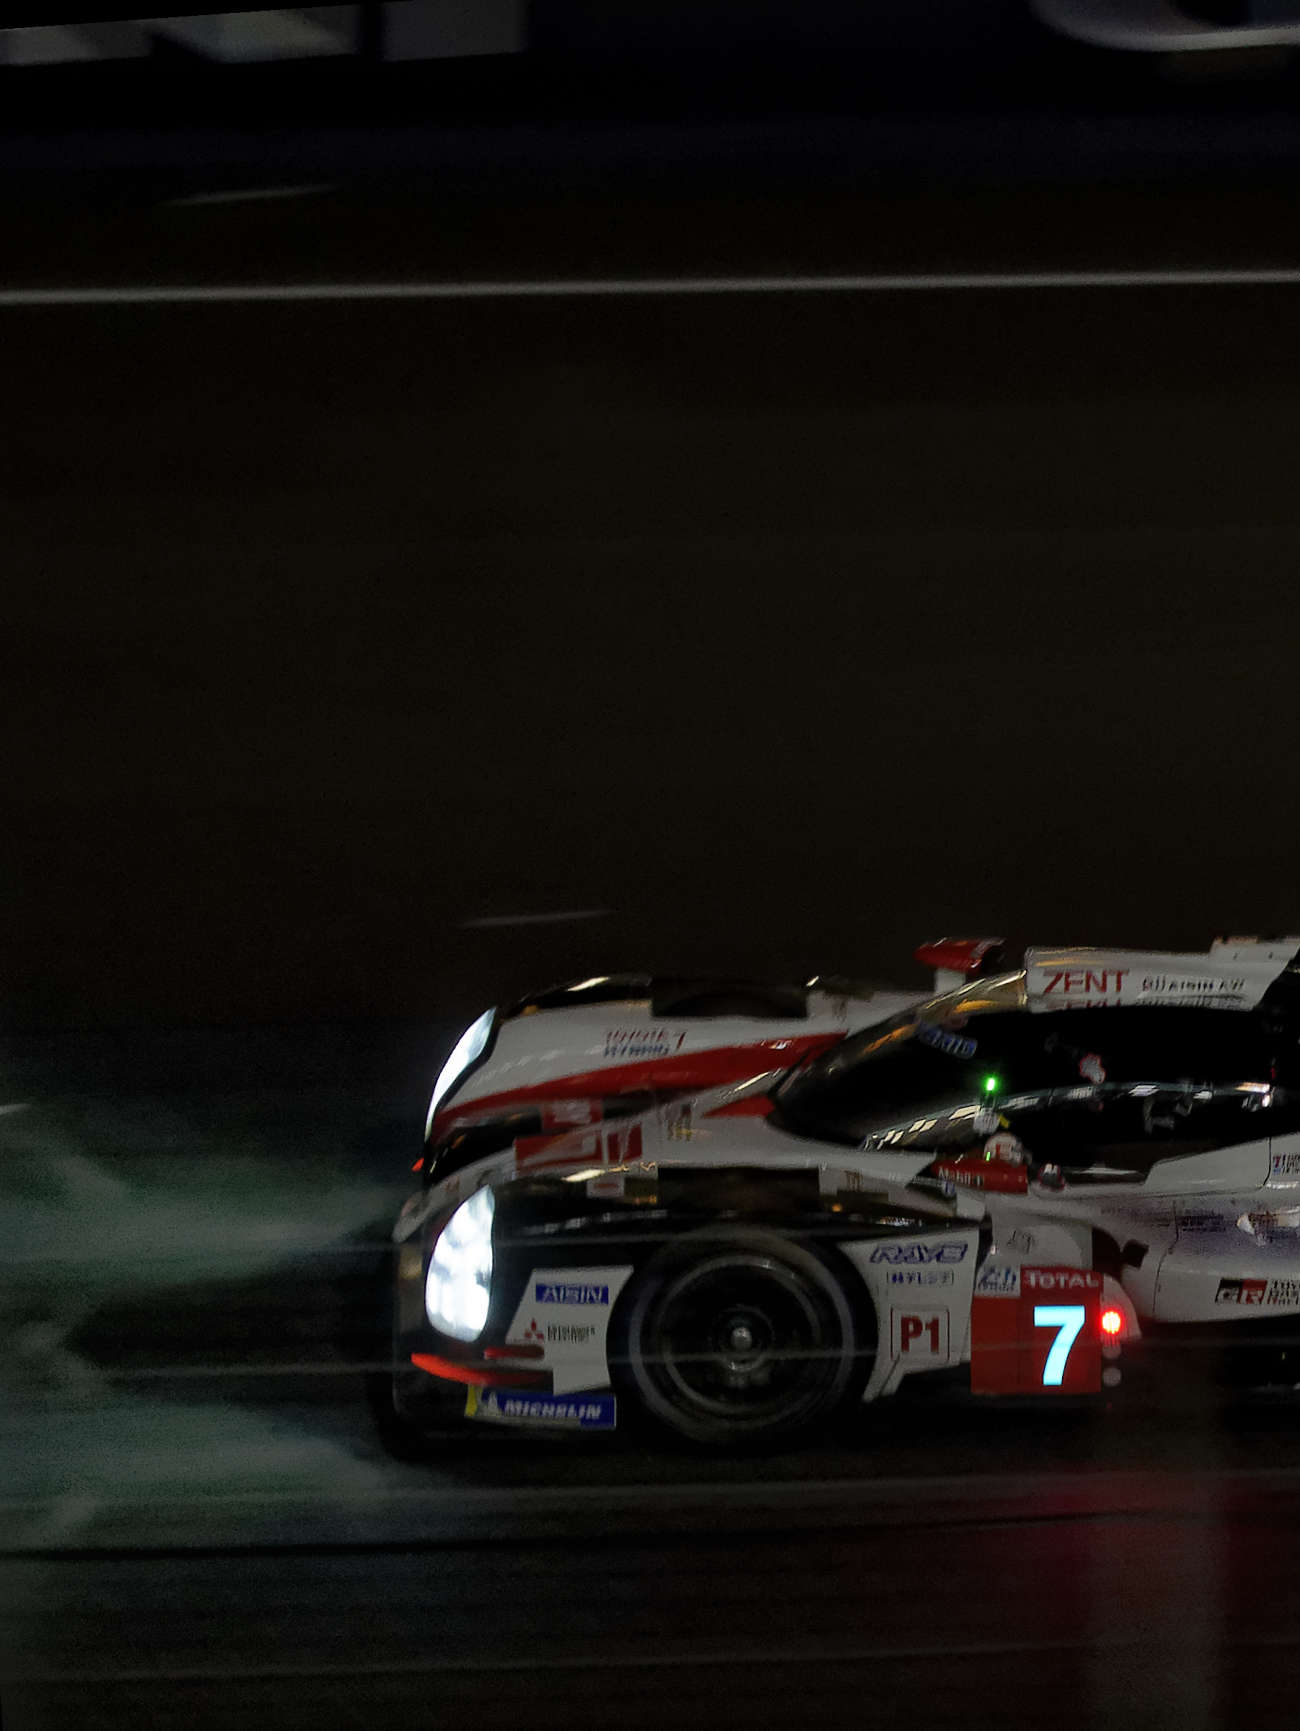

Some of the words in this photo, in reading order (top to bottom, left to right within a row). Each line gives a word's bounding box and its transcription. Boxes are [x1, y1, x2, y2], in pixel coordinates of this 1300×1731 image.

[1043, 969, 1129, 994] ZENT
[1025, 1268, 1099, 1290] TOTAL
[901, 1316, 941, 1353] P1
[1033, 1304, 1087, 1387] 7
[503, 1398, 603, 1421] MICHELIN
